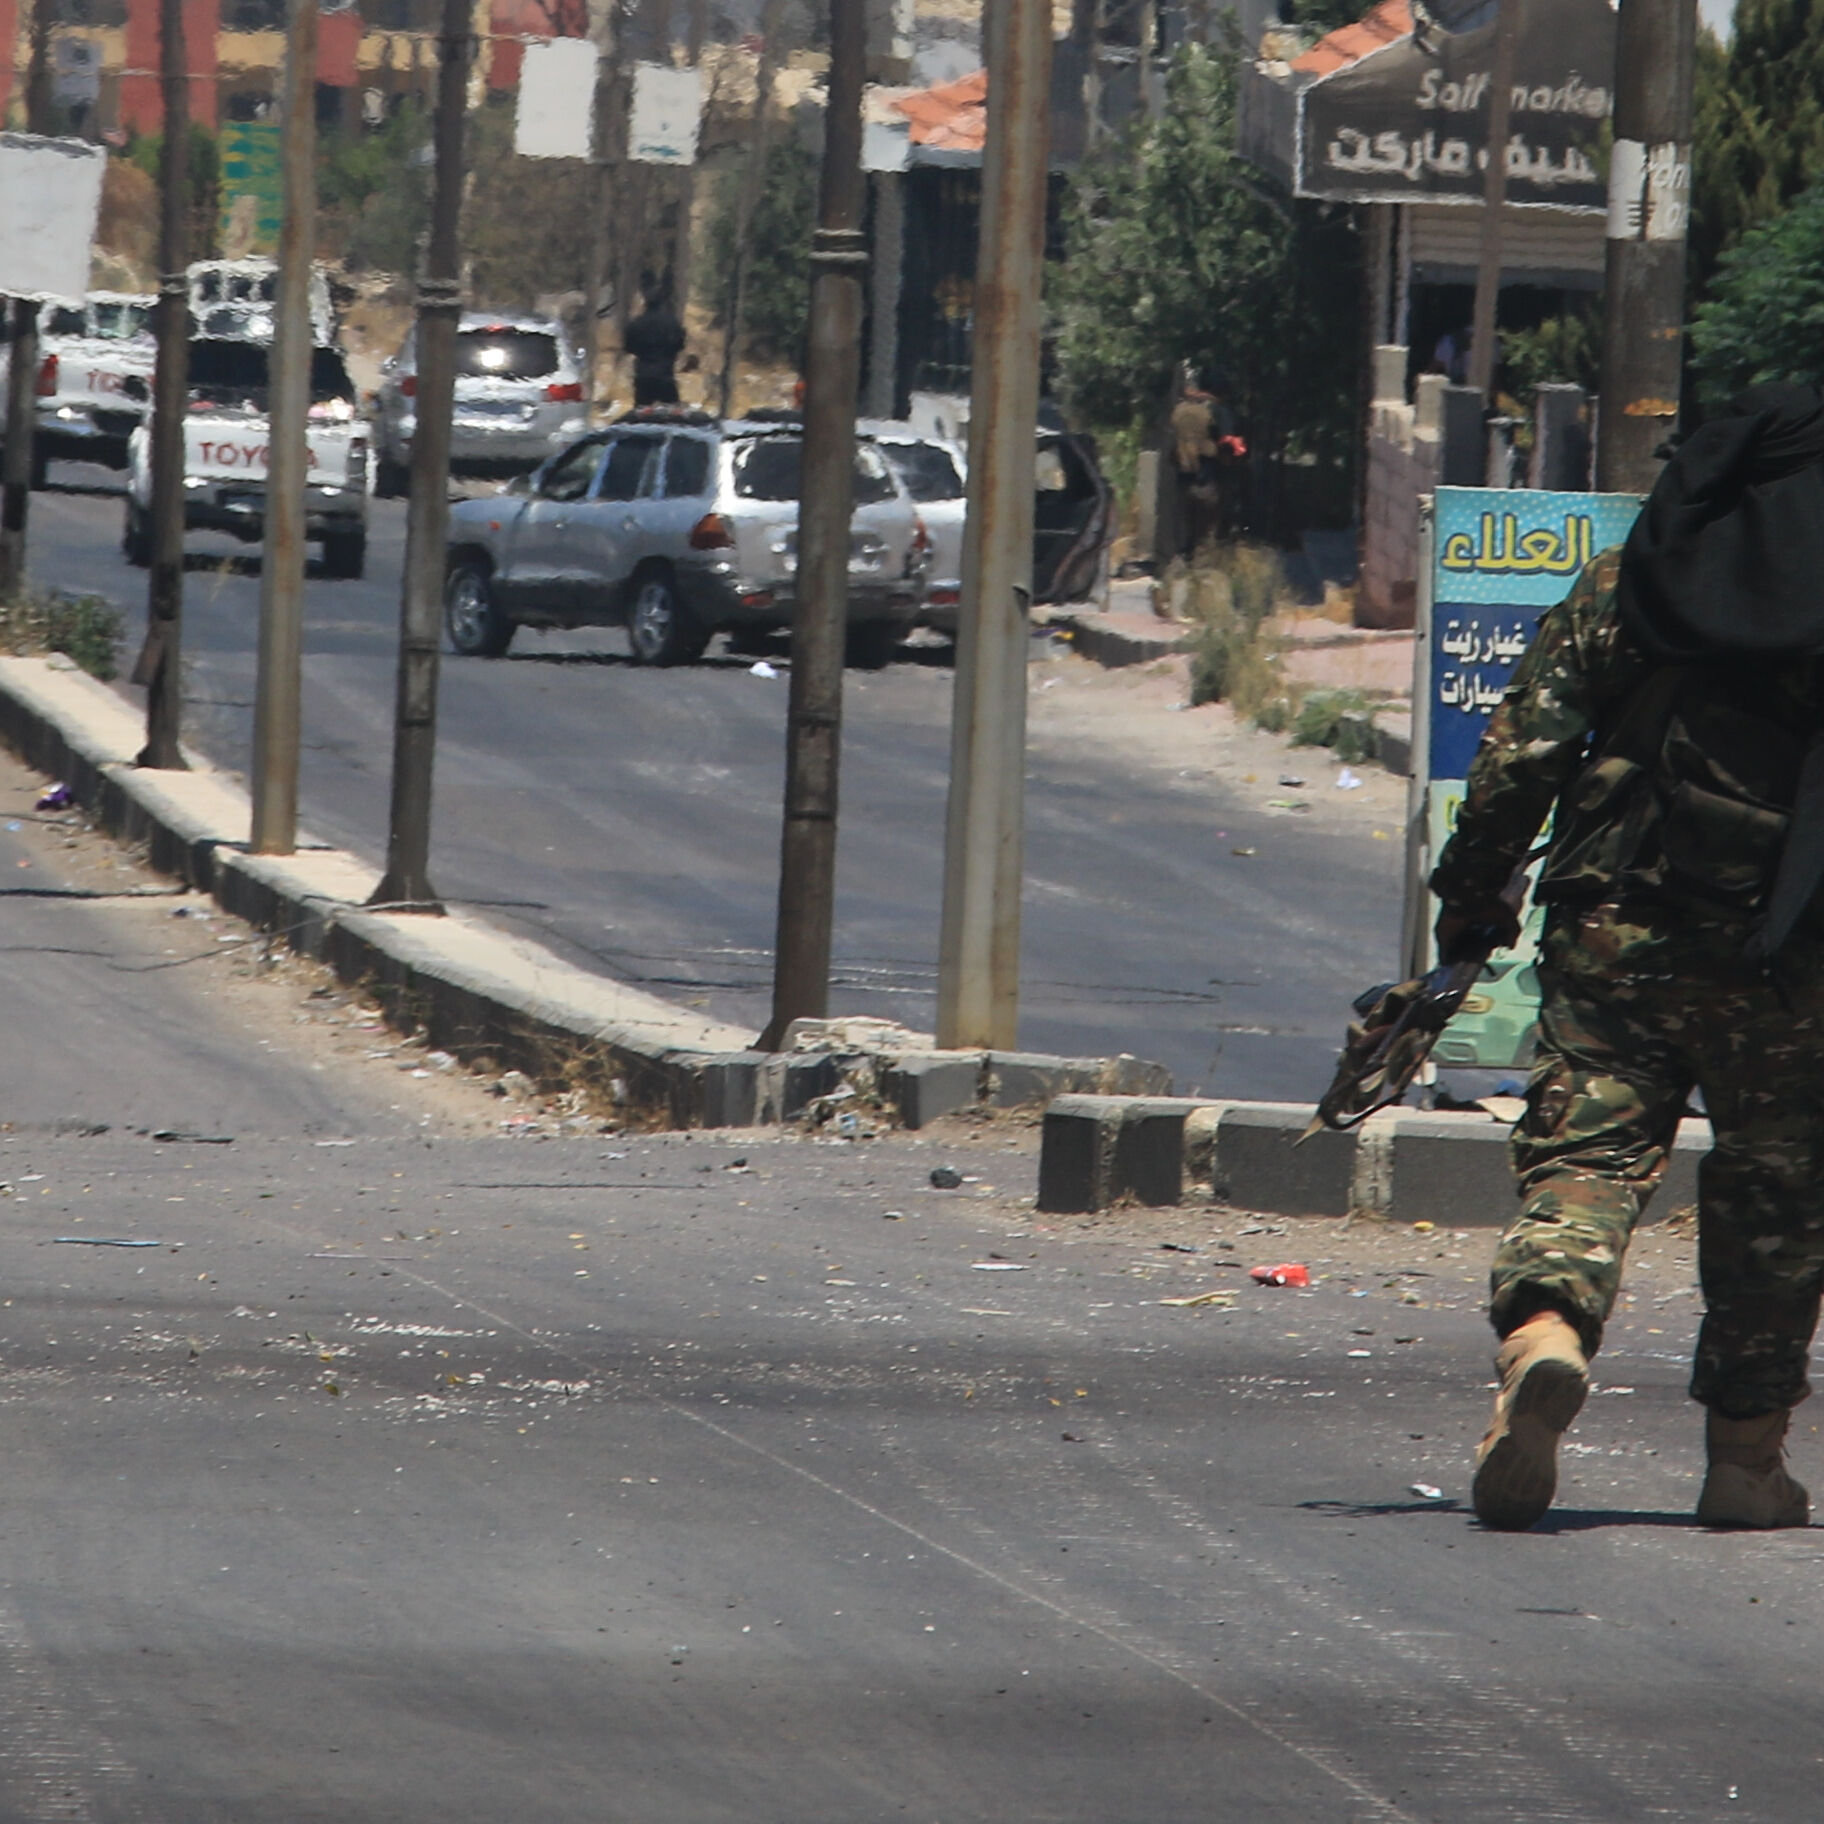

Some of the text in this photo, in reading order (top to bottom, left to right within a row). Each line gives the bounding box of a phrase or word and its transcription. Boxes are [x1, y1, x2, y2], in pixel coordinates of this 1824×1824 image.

[1329, 126, 1473, 182] ماركت
[1441, 512, 1592, 573] العلاء
[1441, 619, 1528, 665] غيار زيت
